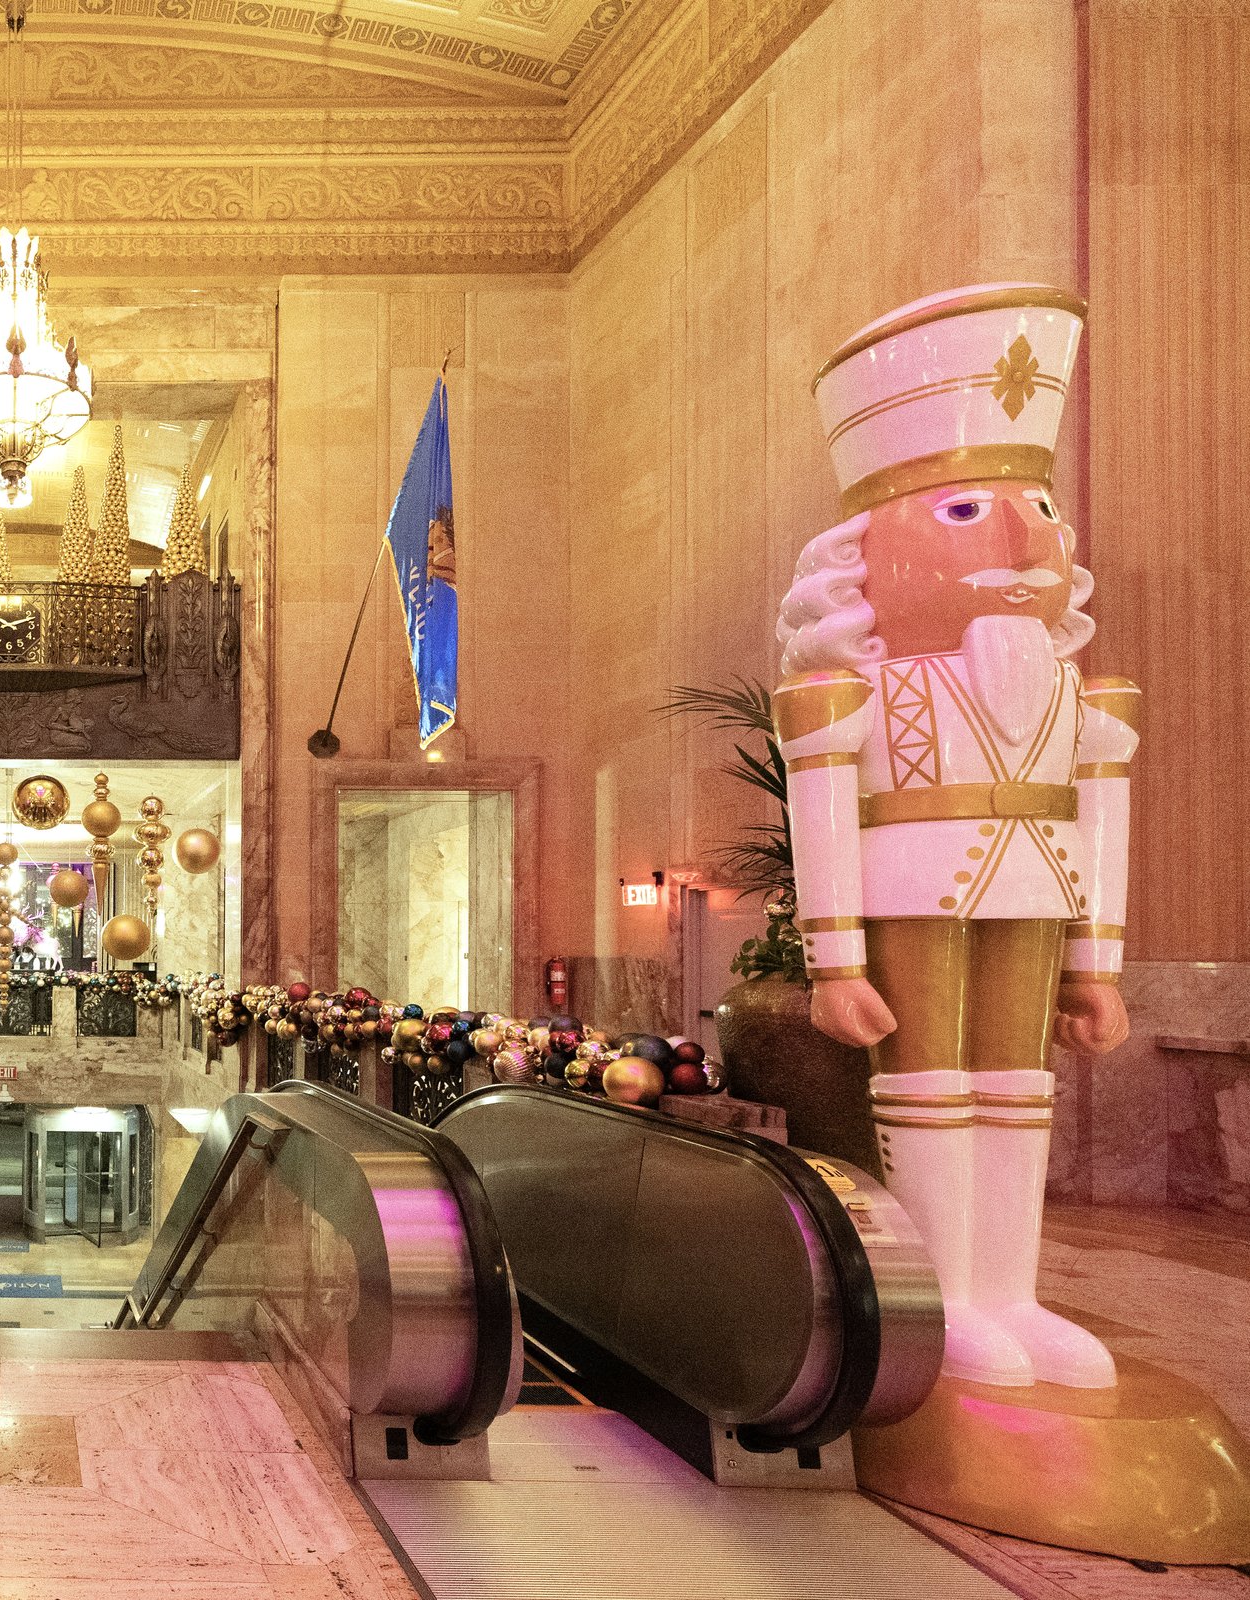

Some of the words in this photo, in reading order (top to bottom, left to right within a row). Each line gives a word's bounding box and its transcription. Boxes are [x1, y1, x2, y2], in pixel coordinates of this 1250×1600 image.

[26, 610, 32, 620] 2
[28, 621, 35, 630] 3
[26, 632, 32, 640] 4
[6, 642, 12, 650] 6
[16, 639, 24, 648] 5
[628, 885, 653, 905] EXIT
